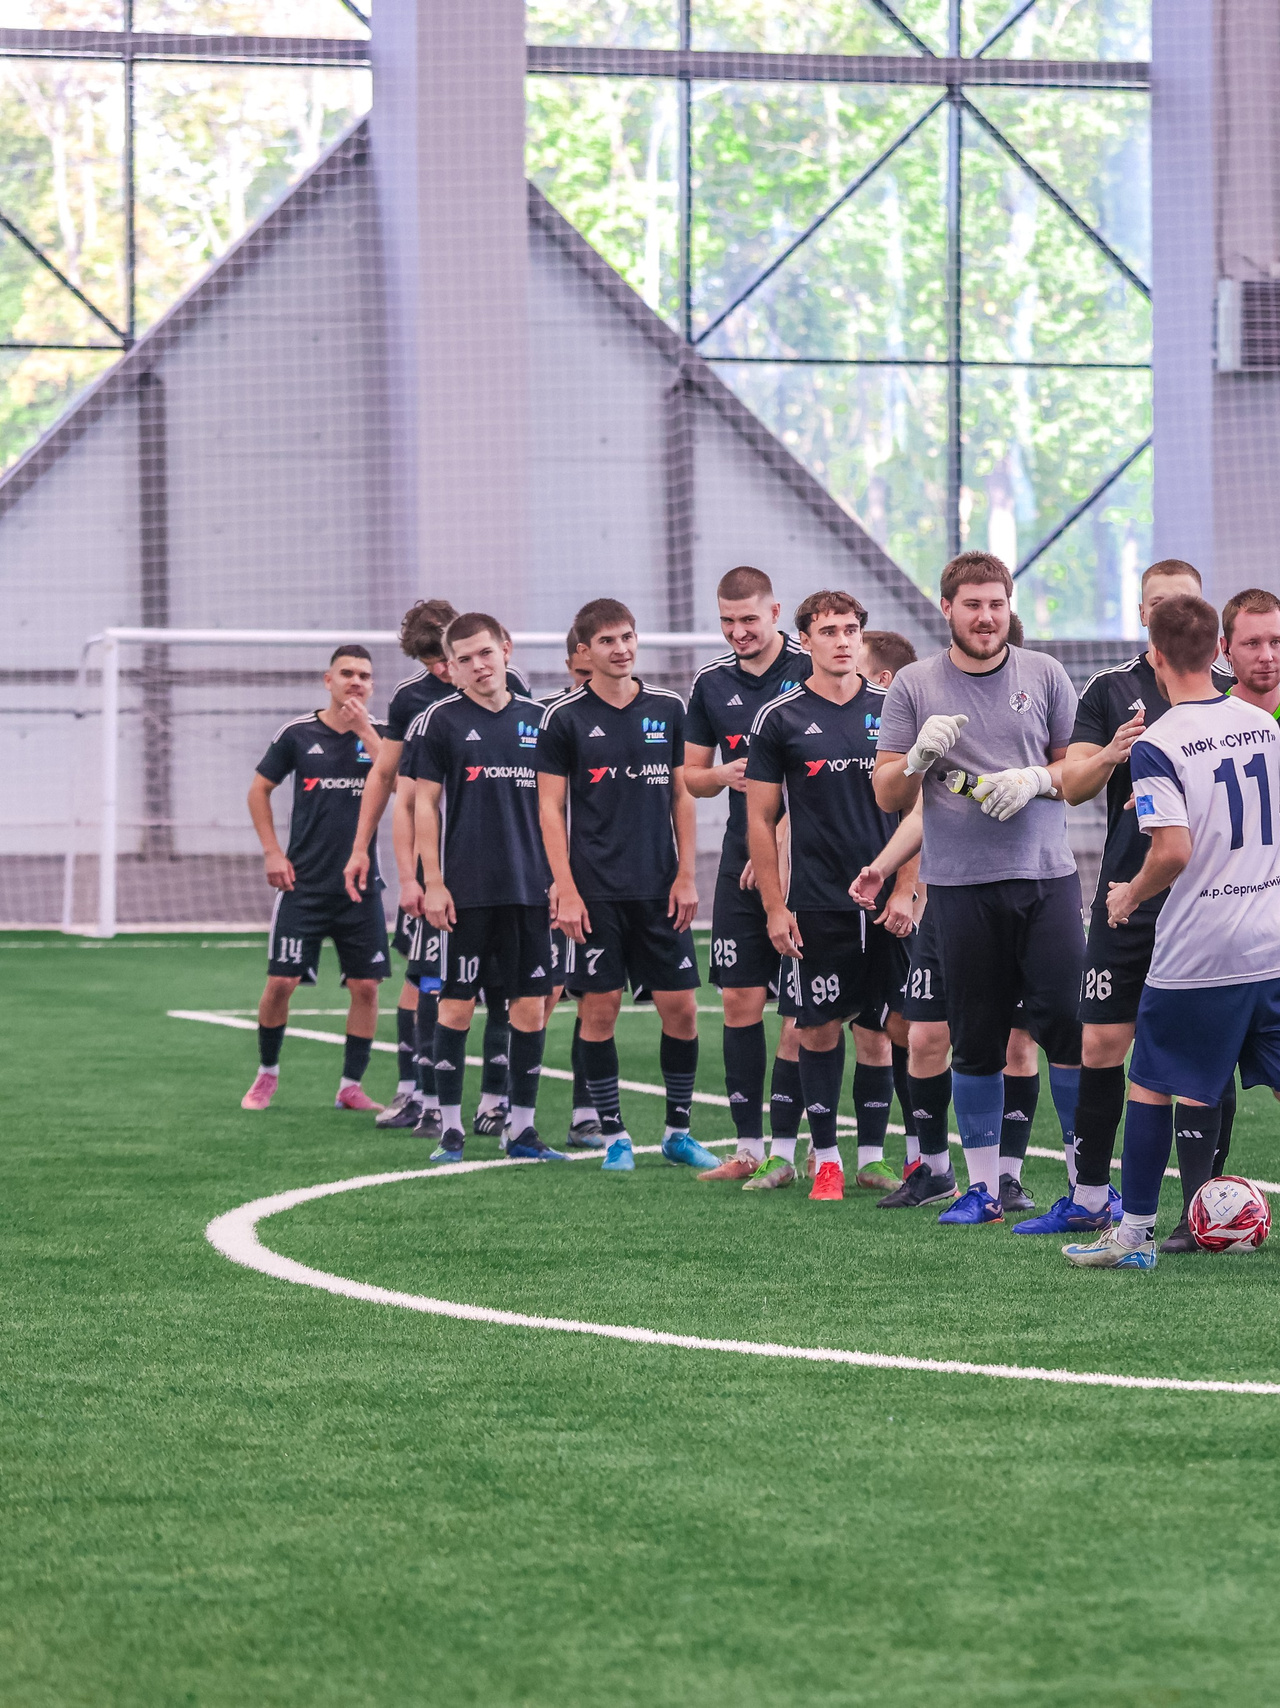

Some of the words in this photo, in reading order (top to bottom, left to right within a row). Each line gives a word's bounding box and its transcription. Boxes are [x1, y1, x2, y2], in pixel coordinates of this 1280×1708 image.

[1181, 736, 1218, 758] МФК
[1219, 729, 1276, 748] «СУРГУТ»
[1214, 752, 1273, 851] 11
[277, 936, 303, 964] 14
[585, 948, 605, 976] 7
[713, 937, 737, 968] 25
[456, 956, 480, 984] 10
[911, 967, 934, 1000] 21
[1085, 967, 1113, 1001] 26
[811, 973, 840, 1006] 99
